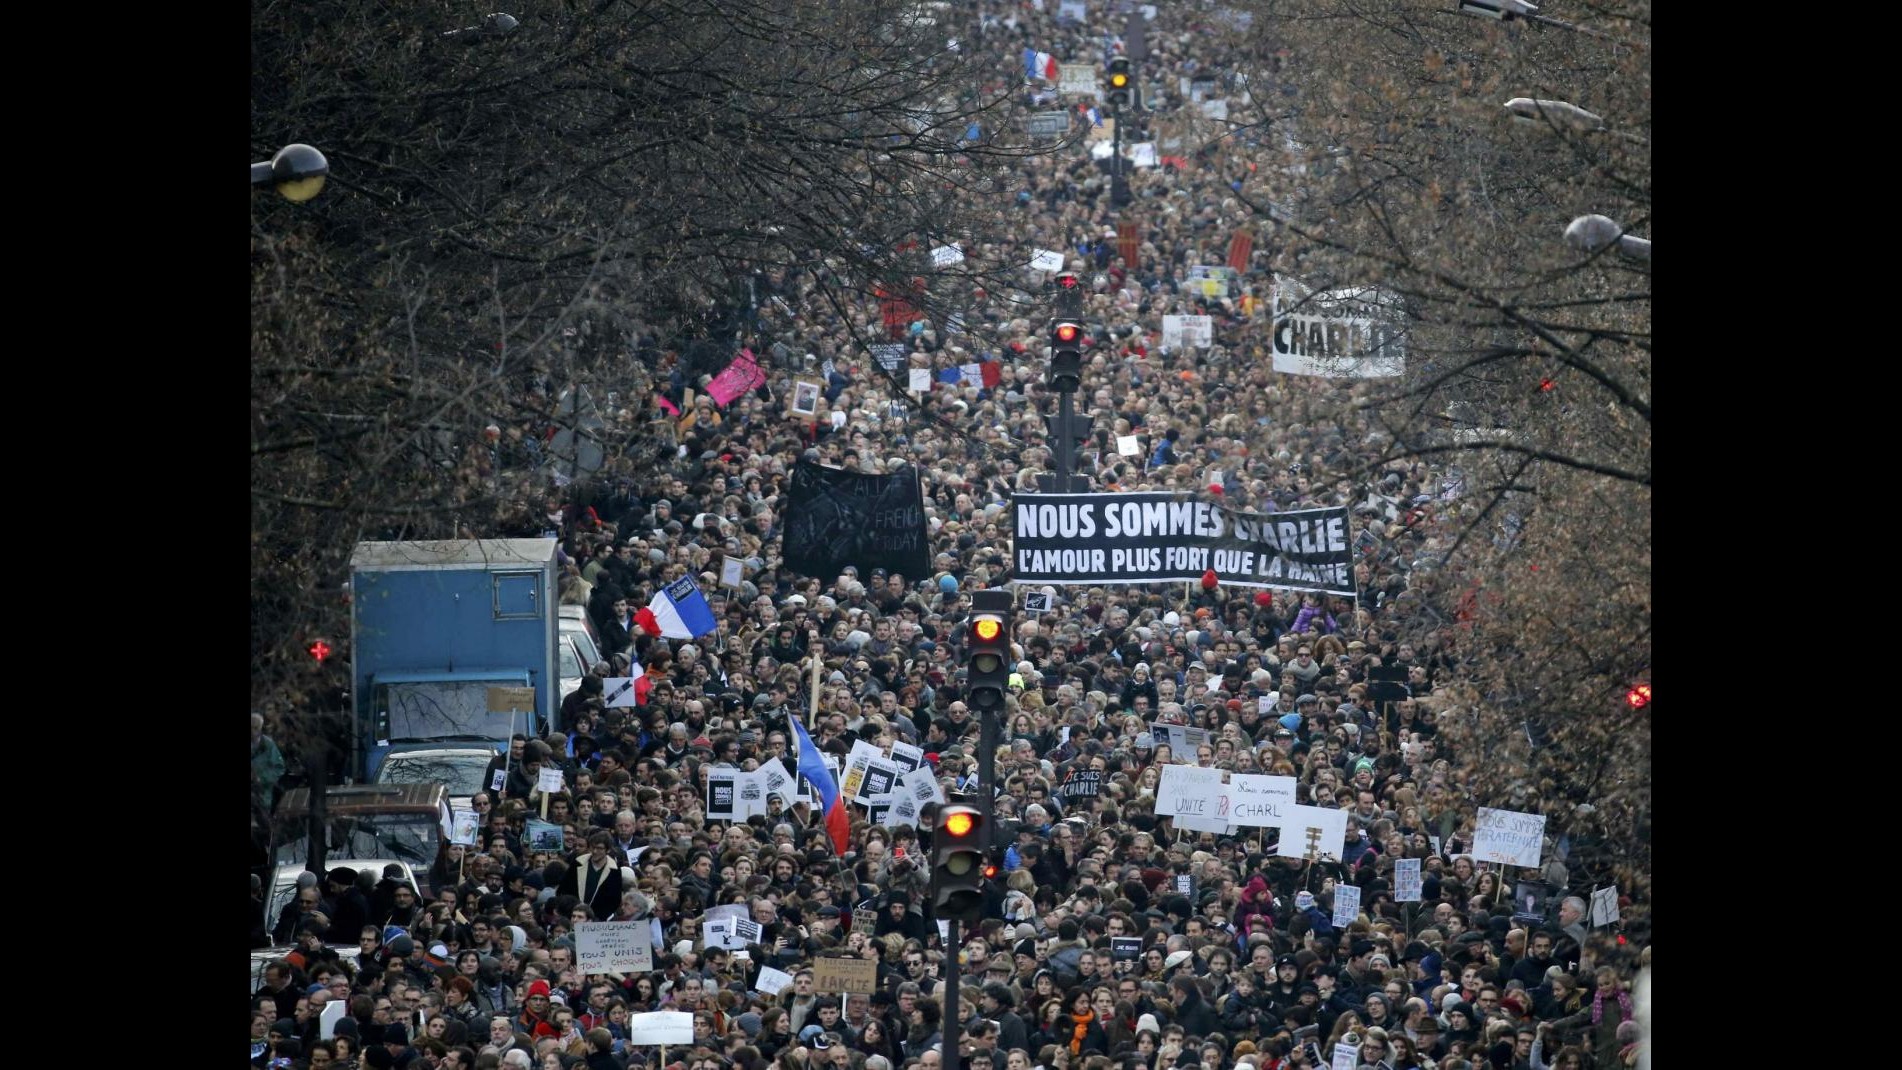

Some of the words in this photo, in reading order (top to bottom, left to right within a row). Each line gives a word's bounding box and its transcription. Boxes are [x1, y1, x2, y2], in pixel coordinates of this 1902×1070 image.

[1018, 502, 1096, 538] NOUS
[1104, 501, 1223, 538] SOMMES
[1019, 548, 1105, 574] L'AMOUR
[1112, 547, 1162, 573] PLUS
[1165, 546, 1209, 572] FORT
[1213, 550, 1253, 576] QUE
[1258, 554, 1283, 578] LA
[1081, 771, 1100, 781] SUIS
[1064, 781, 1099, 797] CHARLIE
[1234, 803, 1282, 818] CHARL
[580, 951, 606, 959] TOUS
[614, 947, 643, 957] UNIS
